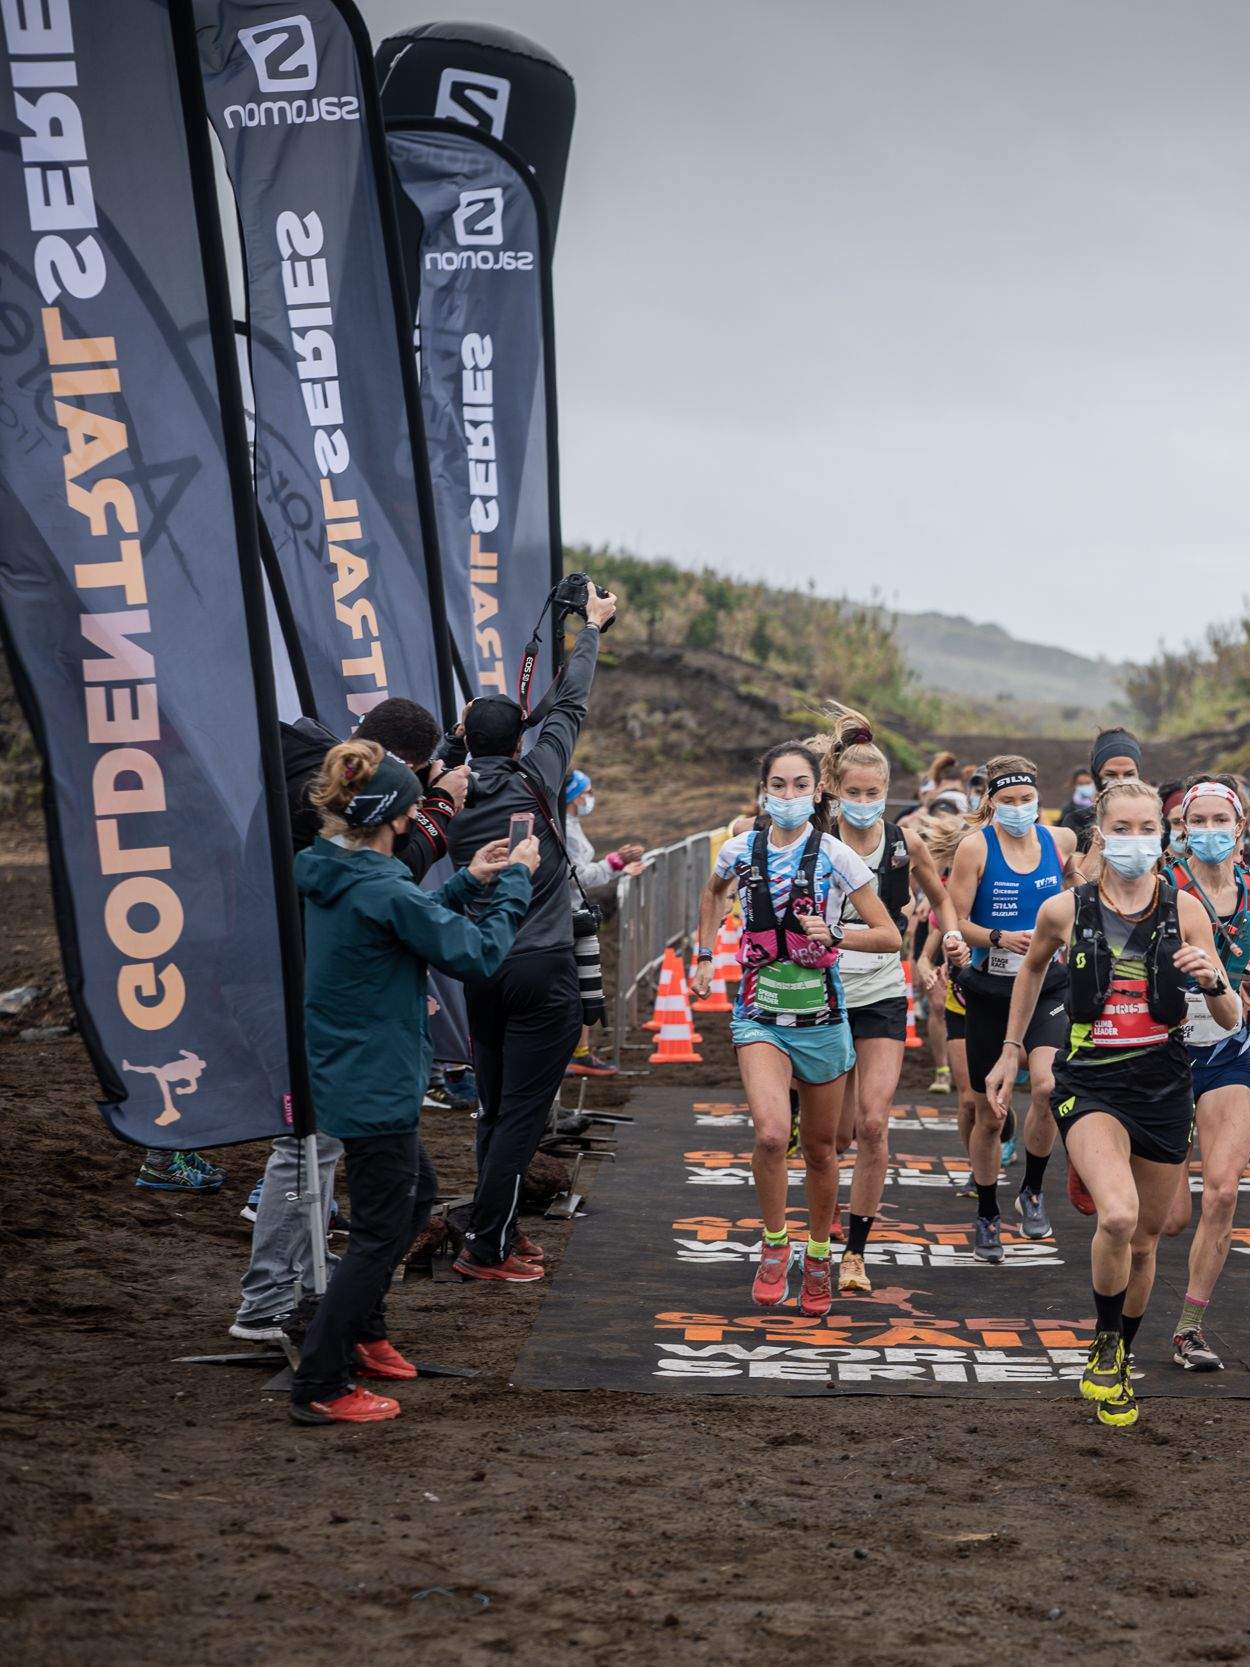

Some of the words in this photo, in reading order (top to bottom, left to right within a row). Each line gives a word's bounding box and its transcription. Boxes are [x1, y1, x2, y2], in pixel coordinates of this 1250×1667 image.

[996, 775, 1033, 787] SILVA
[991, 956, 1009, 965] STAGE
[1094, 1019, 1113, 1028] CLIMB
[1094, 1027, 1119, 1036] LEADER
[655, 1312, 1099, 1330] GOLDEN
[653, 1324, 1097, 1347] TRAIL
